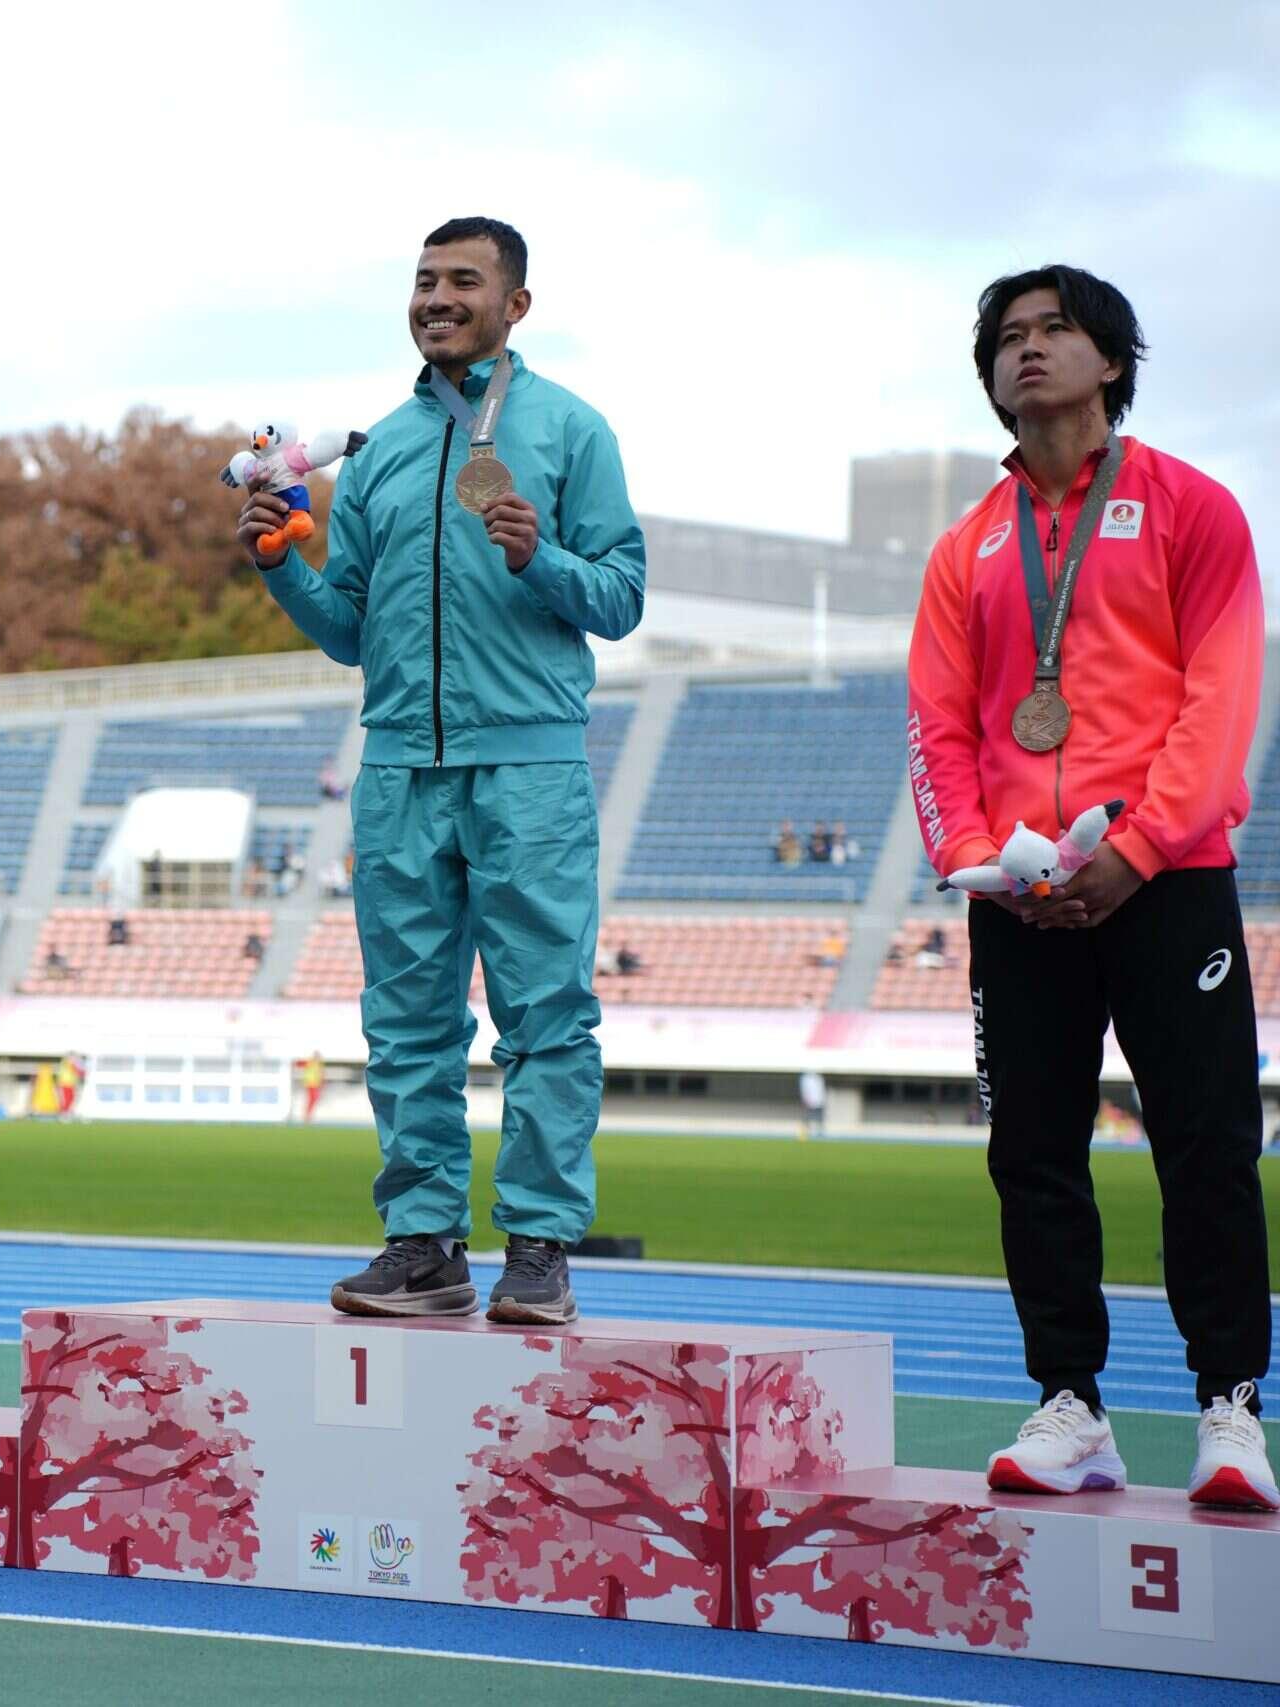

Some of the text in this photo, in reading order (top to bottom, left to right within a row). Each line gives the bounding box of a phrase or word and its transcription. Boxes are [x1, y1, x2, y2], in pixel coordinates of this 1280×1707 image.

[1048, 627, 1059, 656] TOKYO
[907, 710, 947, 851] TEAM JAPAN
[972, 987, 986, 1060] TEAM
[350, 1347, 367, 1405] 1
[1130, 1543, 1180, 1613] 3
